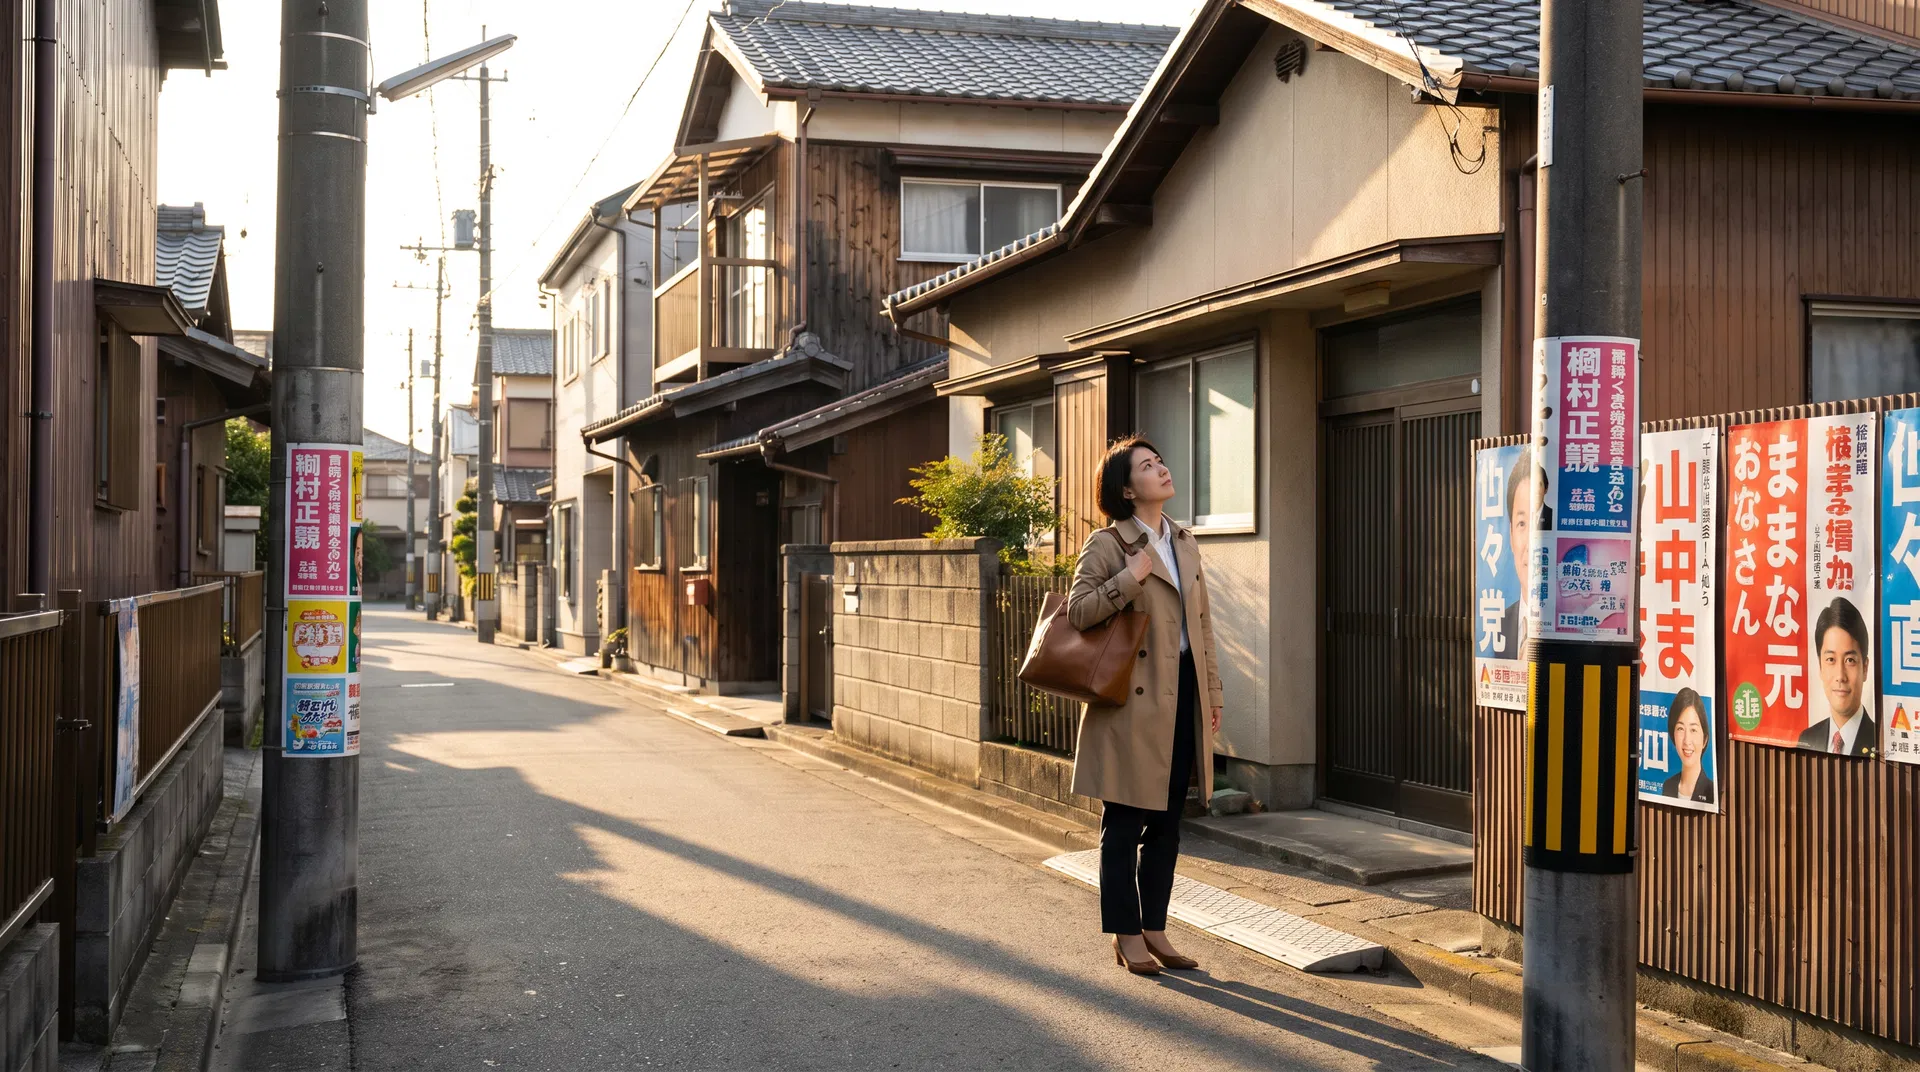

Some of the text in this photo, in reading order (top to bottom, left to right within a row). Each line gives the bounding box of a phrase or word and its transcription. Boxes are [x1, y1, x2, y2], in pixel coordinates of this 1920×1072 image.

[1655, 449, 1697, 679] 山中ま
[1732, 437, 1761, 636] おなさん
[1765, 434, 1803, 709] ままな元
